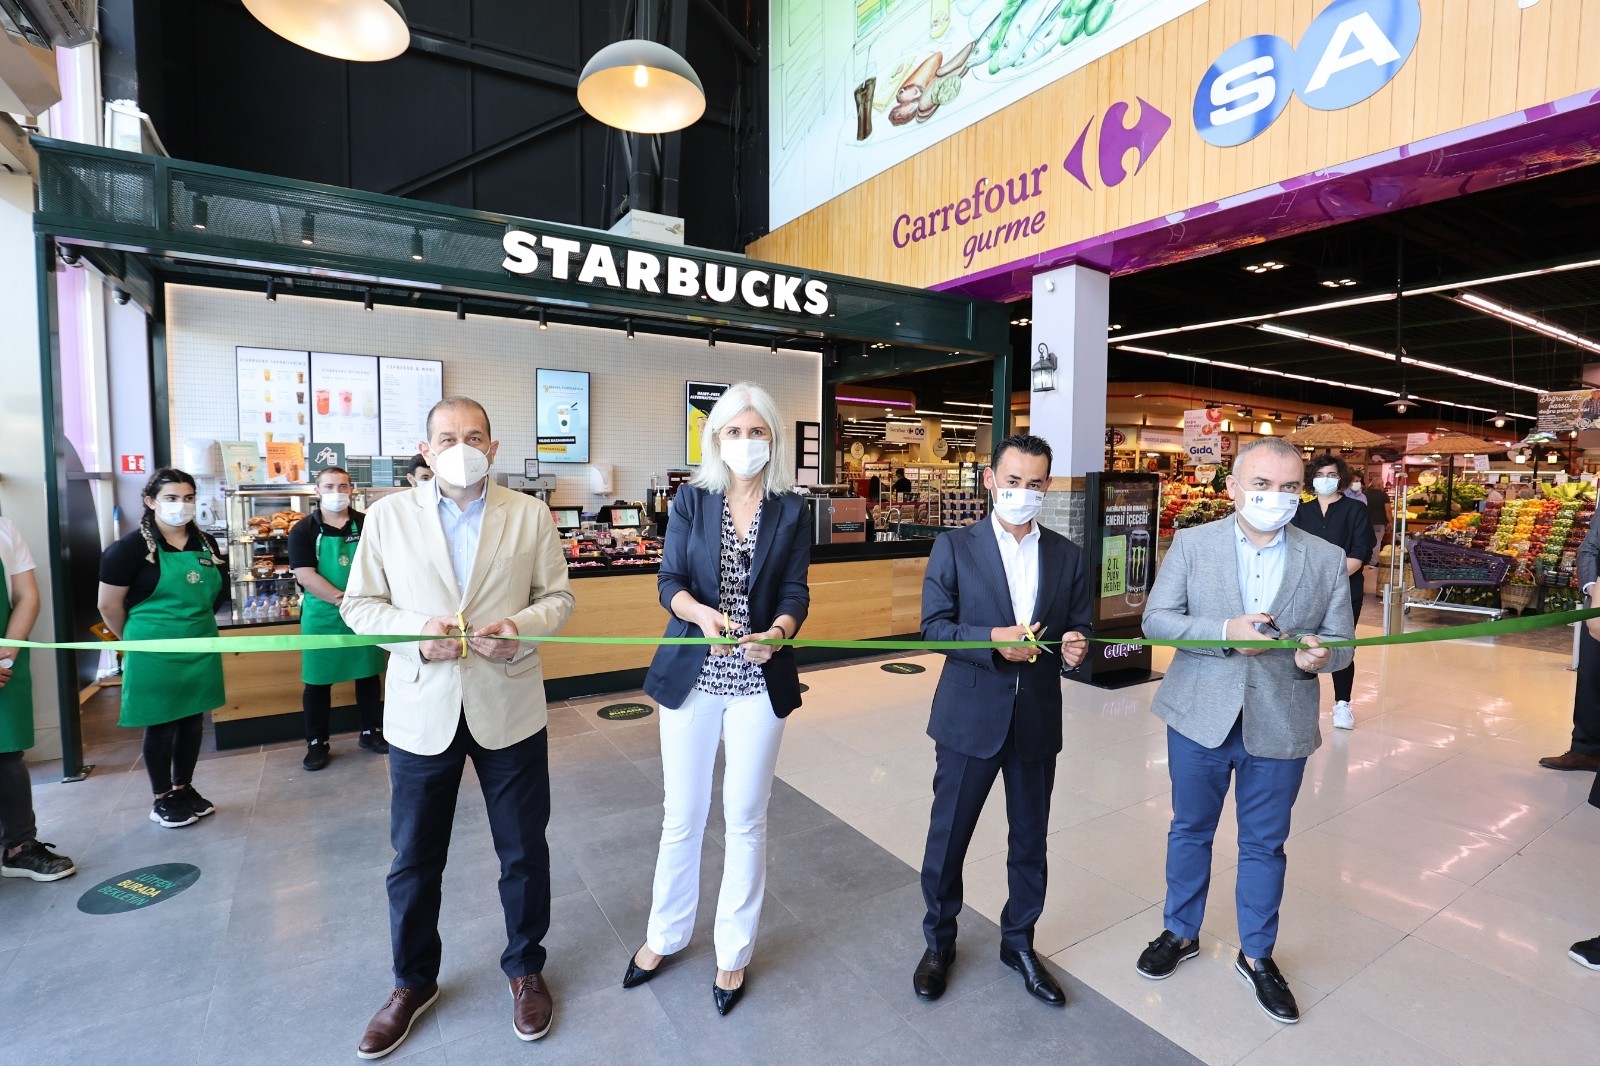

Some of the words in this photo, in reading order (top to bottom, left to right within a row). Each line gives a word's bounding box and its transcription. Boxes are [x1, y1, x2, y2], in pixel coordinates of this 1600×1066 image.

[1210, 11, 1402, 127] SA
[893, 164, 1048, 248] Carrefour
[963, 210, 1046, 269] gurme
[502, 230, 829, 315] STARBUCKS
[1106, 512, 1125, 526] ENERJİ
[1108, 558, 1112, 570] 2
[1113, 558, 1119, 570] TL
[116, 879, 162, 898] BURADA
[134, 874, 176, 889] LÜTFEN
[98, 886, 149, 906] BEKLEYİN
